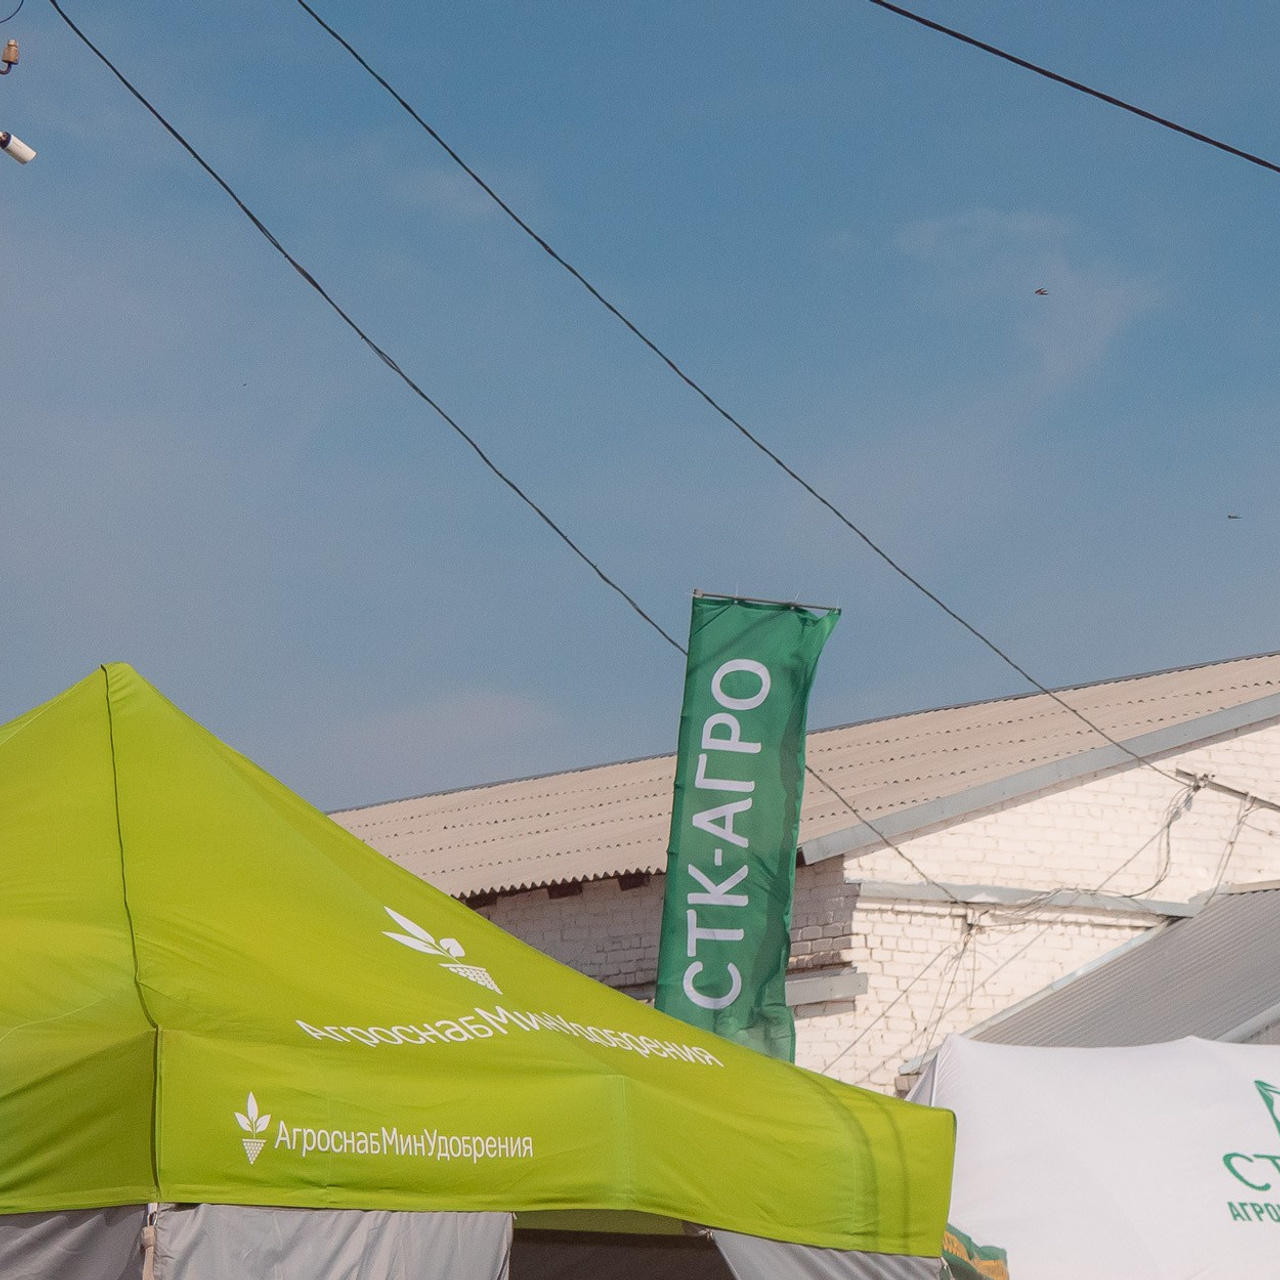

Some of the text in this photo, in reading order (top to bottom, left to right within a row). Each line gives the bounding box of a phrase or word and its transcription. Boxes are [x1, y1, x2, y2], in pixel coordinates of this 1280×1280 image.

[683, 658, 771, 1010] СТК-АГРО
[295, 1005, 724, 1068] АгроснабМинУдобрения
[274, 1120, 533, 1163] АгроснабМинУдобрения
